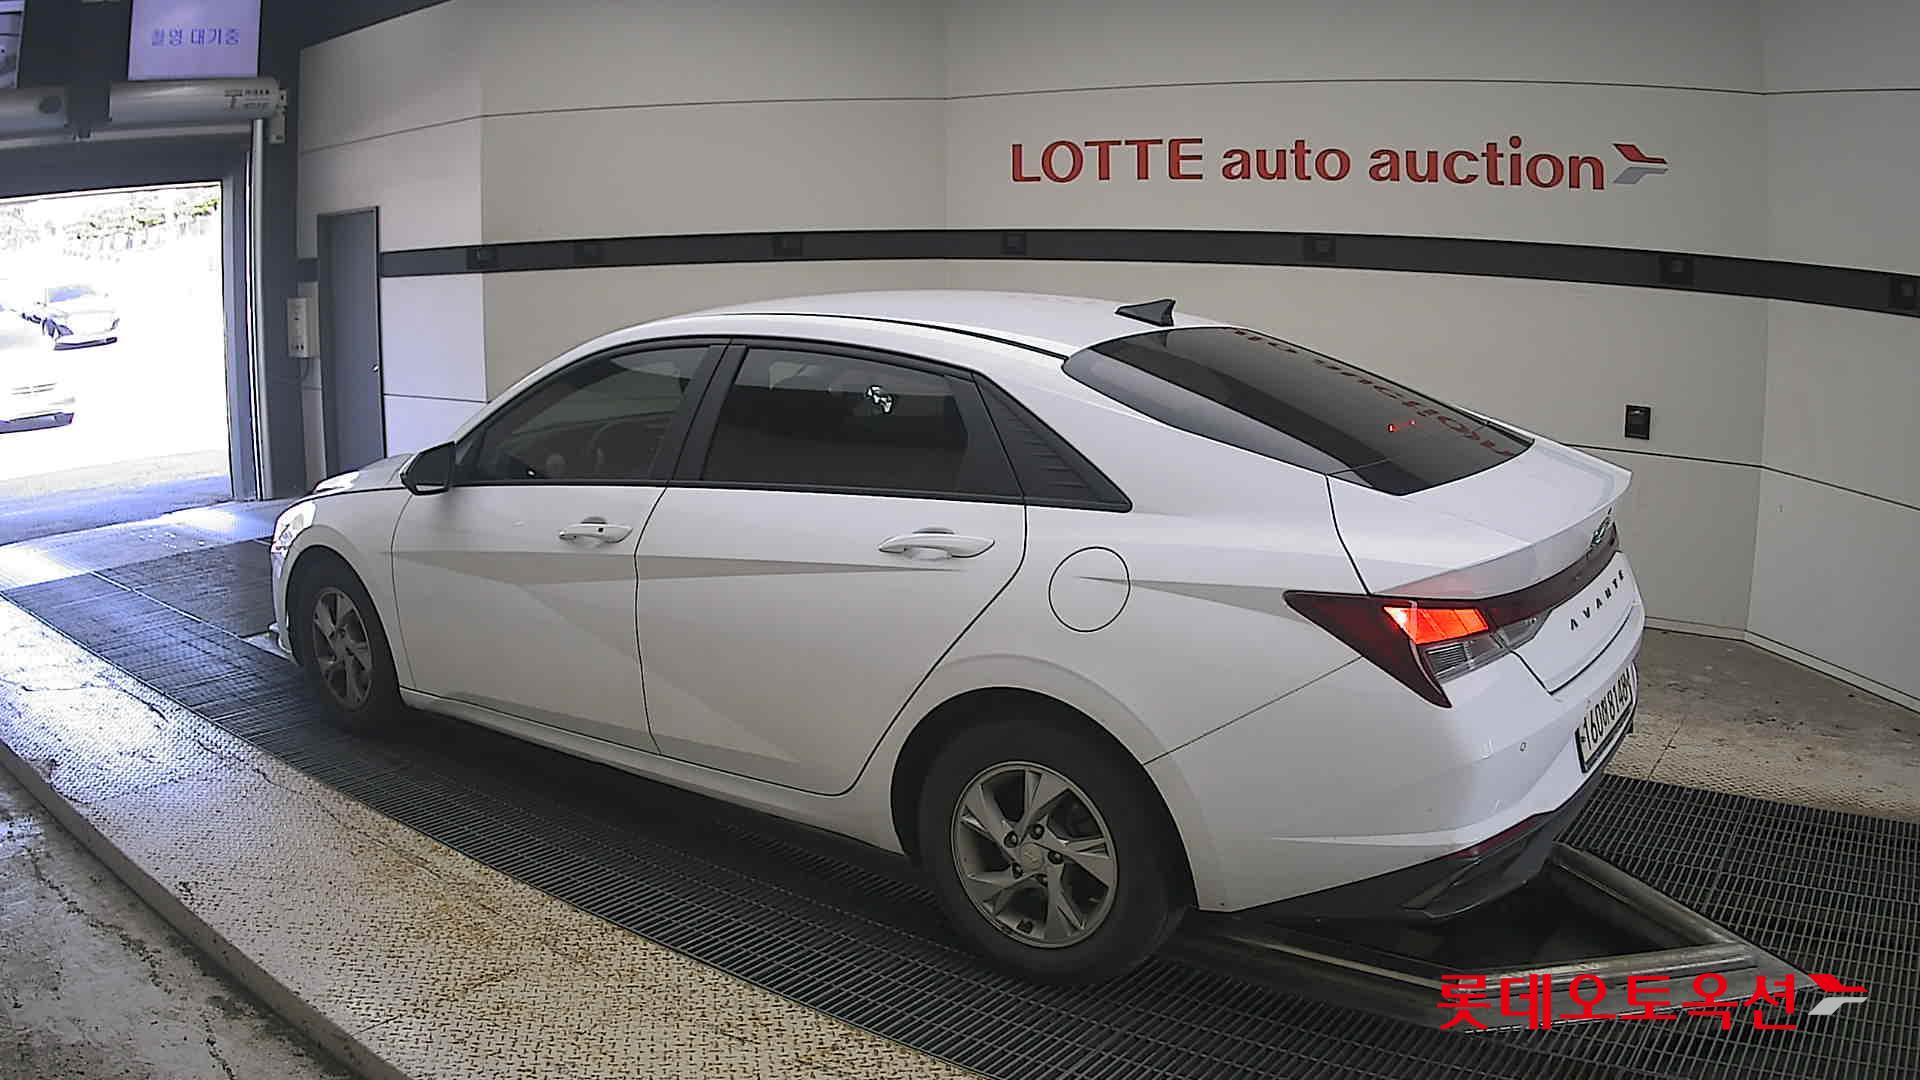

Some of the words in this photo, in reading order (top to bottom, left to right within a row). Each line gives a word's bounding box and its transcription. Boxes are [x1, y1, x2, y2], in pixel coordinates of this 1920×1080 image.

[191, 27, 240, 46] 대기중
[1011, 138, 1203, 183] LOTTE
[1221, 139, 1352, 182] auto
[1368, 135, 1605, 191] auction
[1569, 569, 1624, 631] AVANTE
